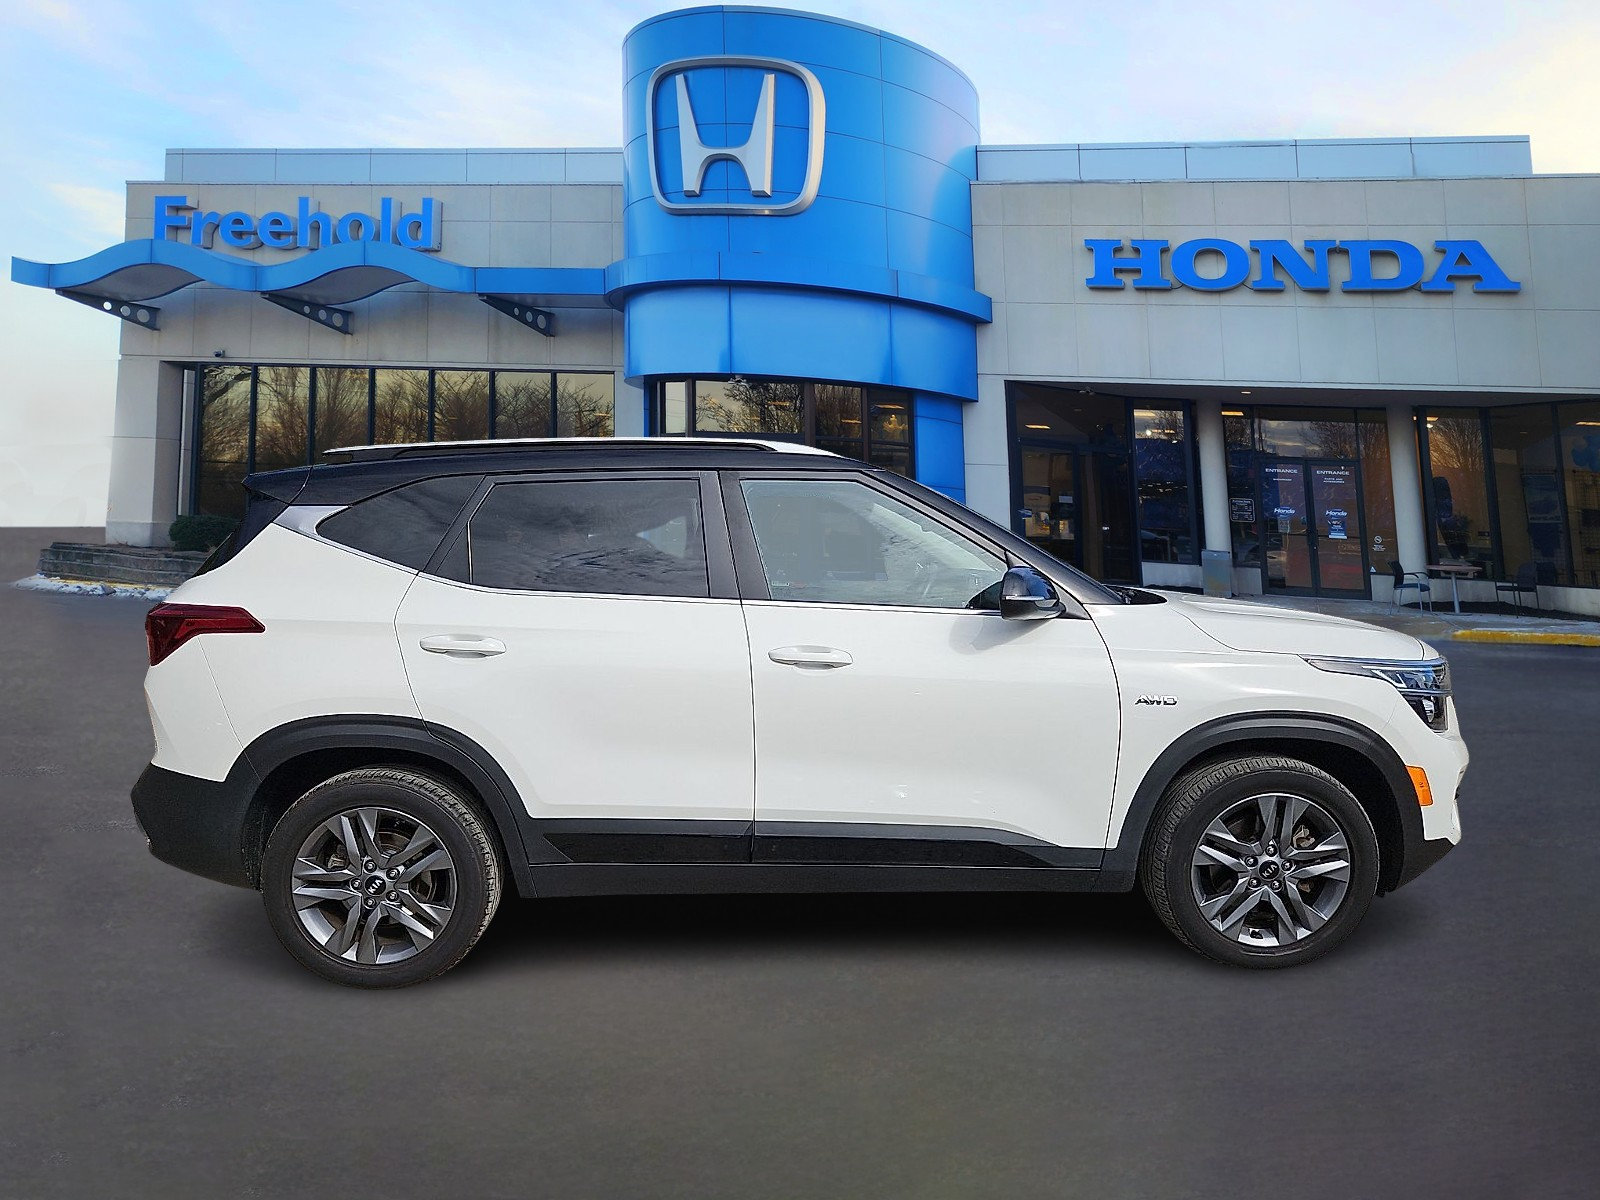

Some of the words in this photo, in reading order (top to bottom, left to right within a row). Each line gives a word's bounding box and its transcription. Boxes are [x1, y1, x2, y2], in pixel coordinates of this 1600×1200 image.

[154, 195, 439, 250] Freehold
[1084, 238, 1521, 293] HONDA
[1273, 507, 1296, 515] Honda
[1325, 509, 1348, 517] Honda
[1135, 694, 1178, 706] AWD
[1261, 864, 1278, 878] KIA
[367, 879, 383, 894] KIA
